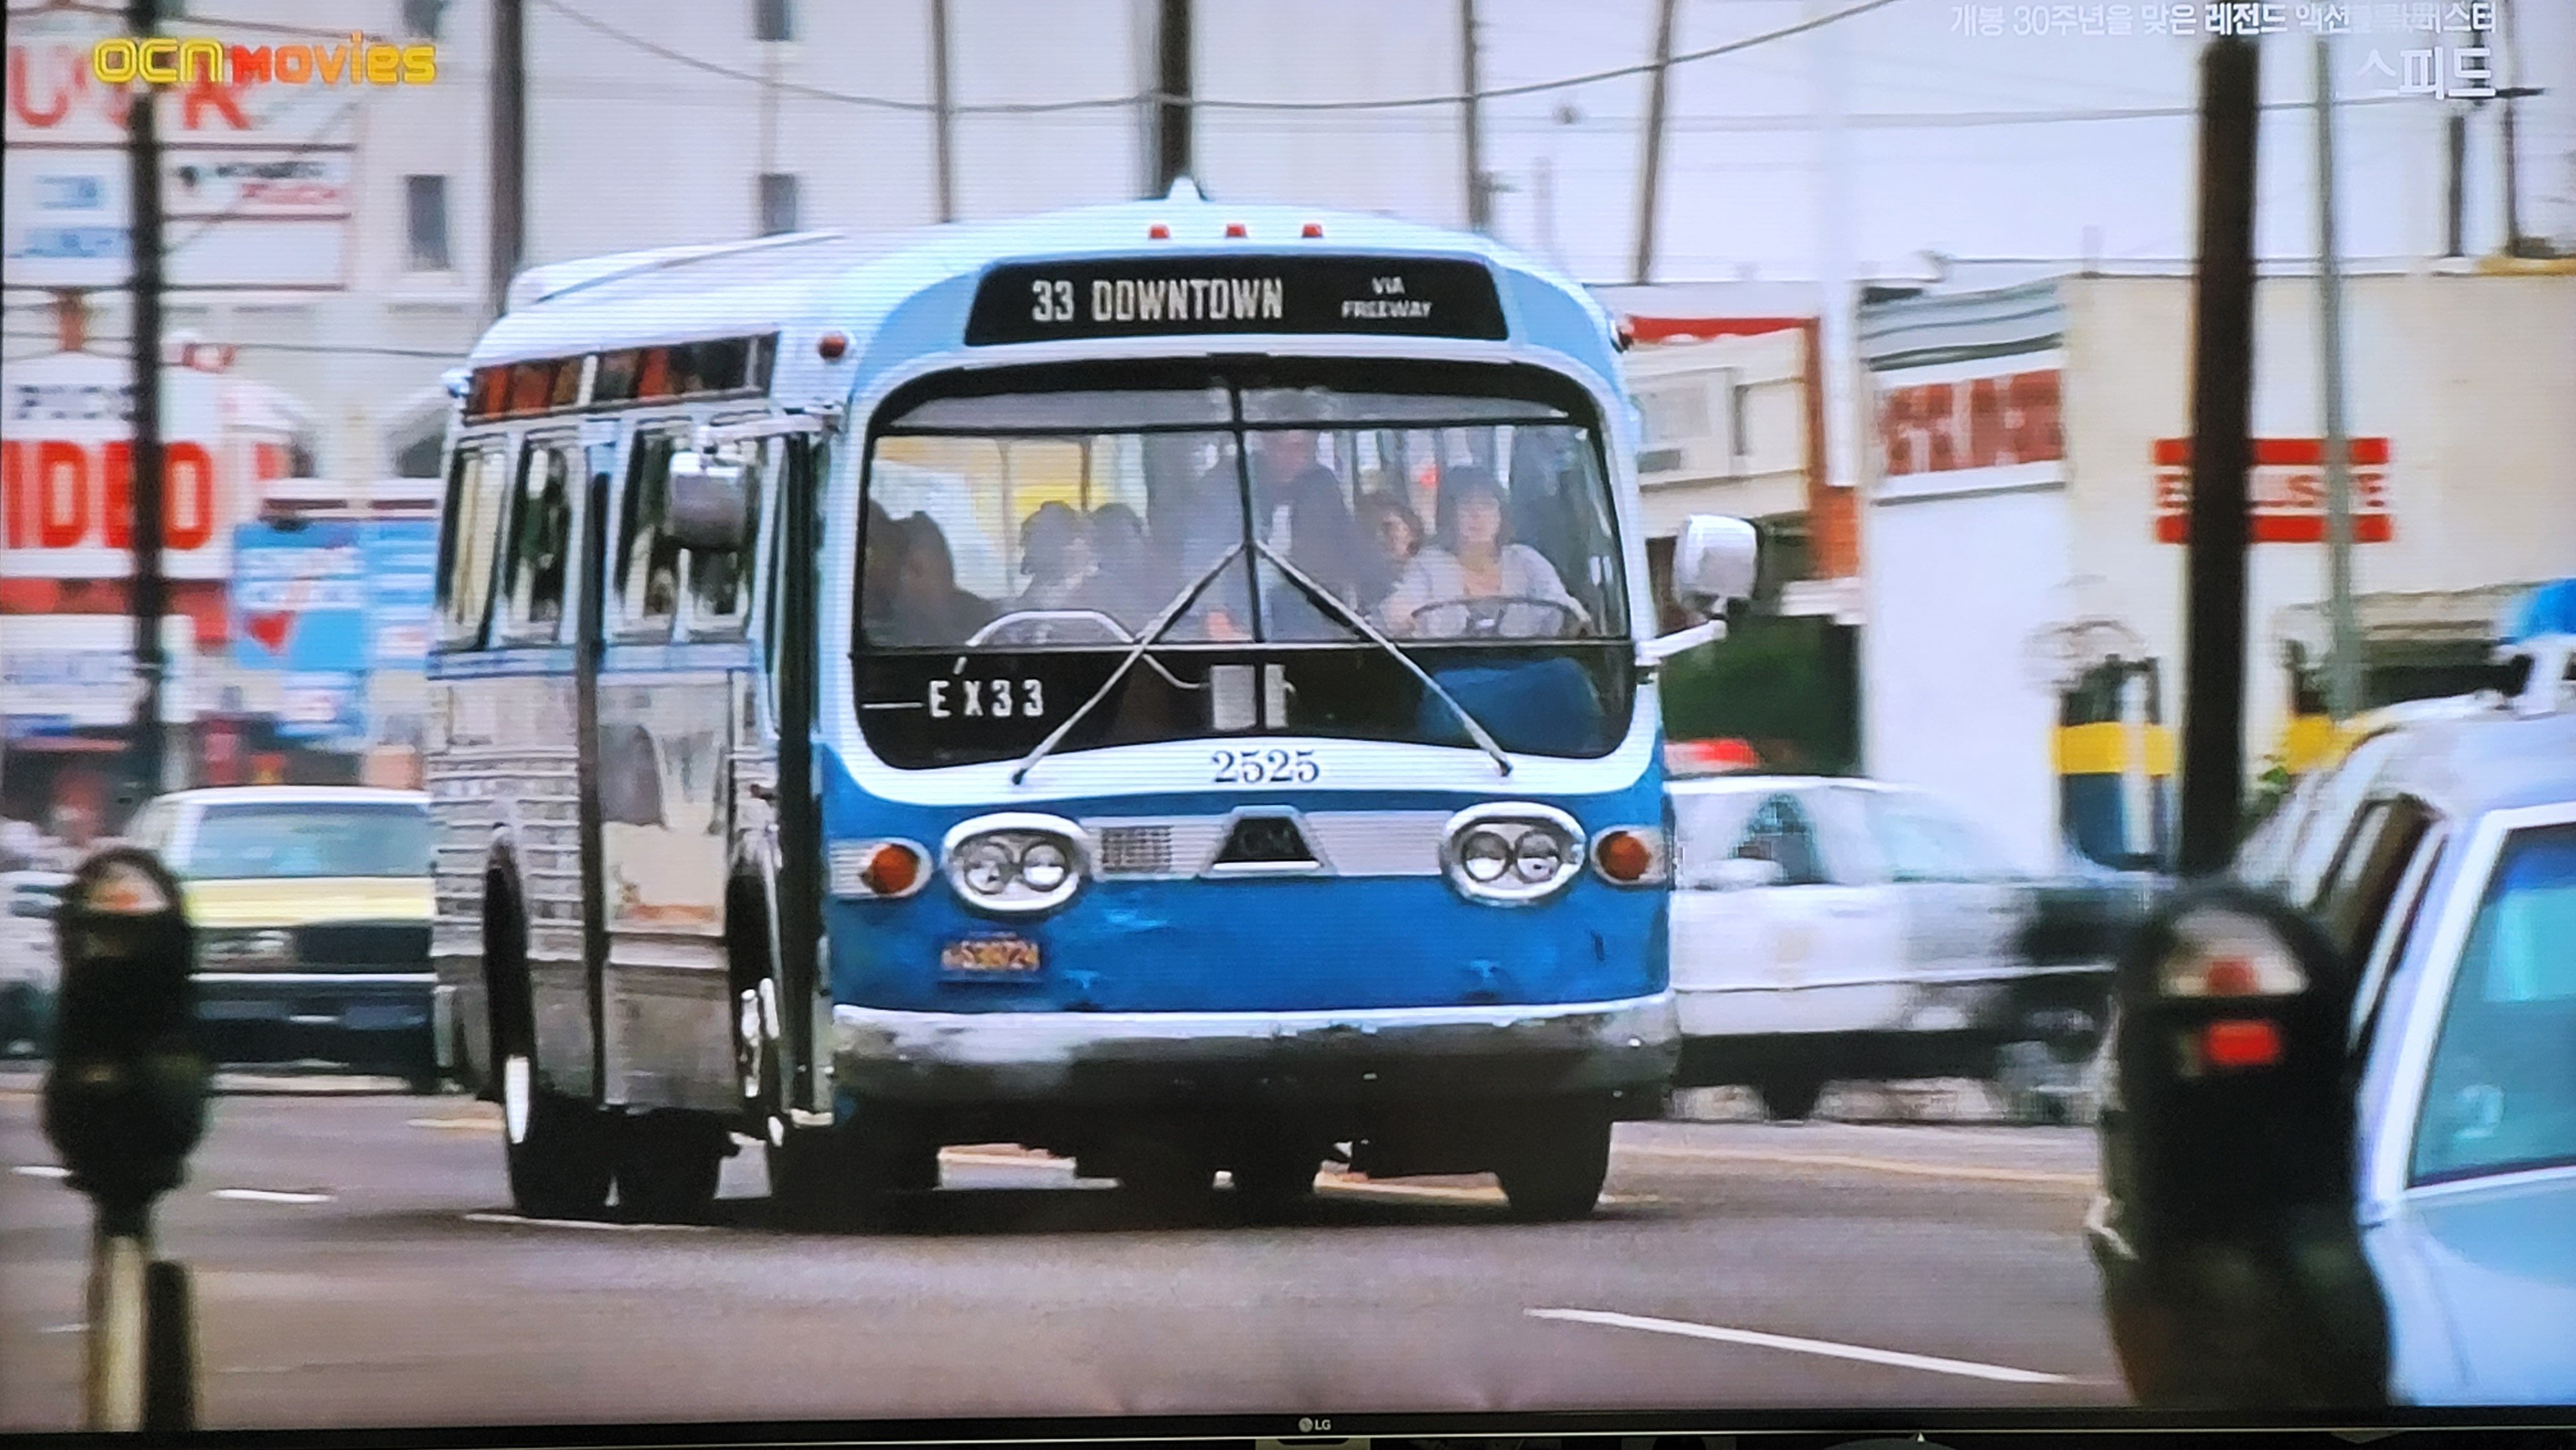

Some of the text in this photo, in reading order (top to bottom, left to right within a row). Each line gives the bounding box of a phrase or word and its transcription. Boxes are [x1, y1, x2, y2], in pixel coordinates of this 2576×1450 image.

[1951, 4, 2006, 37] 개봉
[2013, 4, 2133, 37] 30주년을
[2141, 3, 2197, 36] 맞은
[2205, 3, 2287, 35] 레전드
[2336, 46, 2496, 100] 스피드
[1032, 278, 1282, 321] 33 DOWNTOWN
[1372, 276, 1405, 296] VIA
[1341, 299, 1433, 319] FREEWAY
[1211, 749, 1321, 784] 2525
[1315, 1419, 1331, 1430] LG
